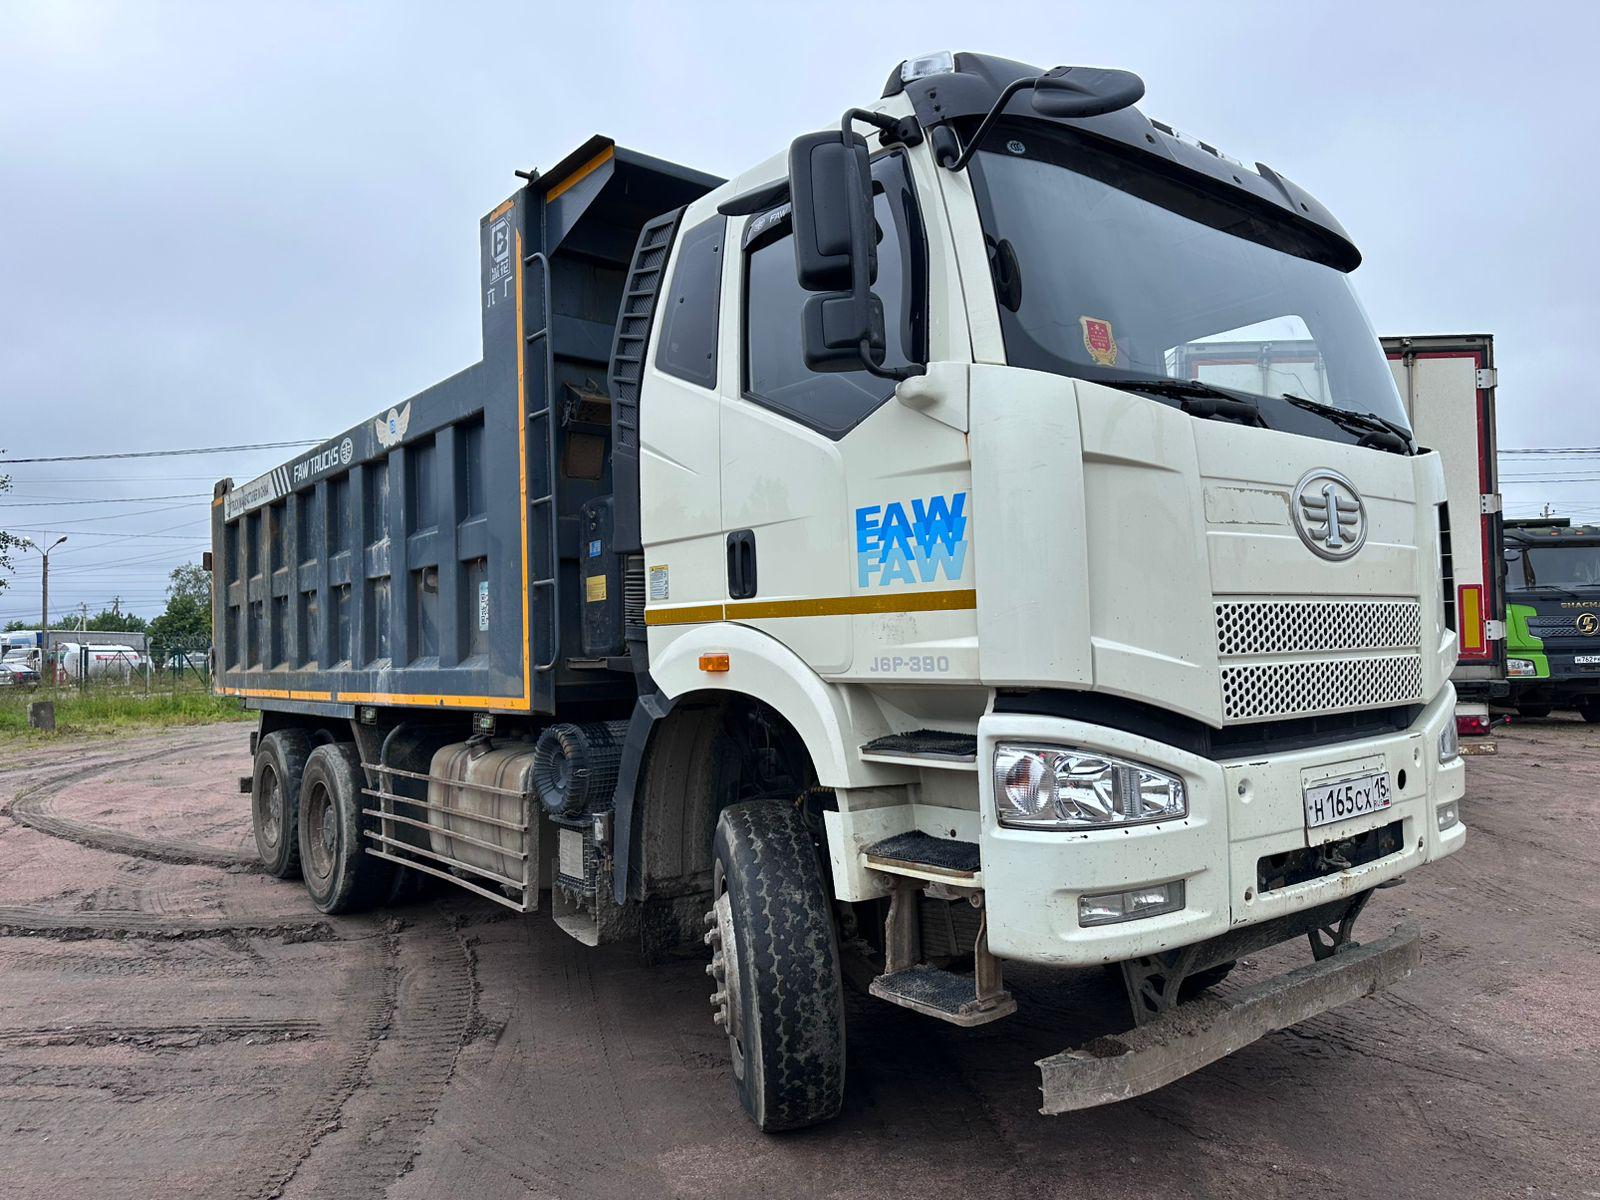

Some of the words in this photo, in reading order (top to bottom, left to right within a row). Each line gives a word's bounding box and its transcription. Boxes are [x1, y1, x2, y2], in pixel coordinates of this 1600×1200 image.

[769, 208, 788, 223] FAW
[293, 459, 309, 483] FAW
[310, 446, 339, 475] TRUCKS
[855, 492, 967, 541] FAW
[858, 540, 969, 588] FAW
[870, 655, 949, 673] J6P-390
[1374, 777, 1387, 798] 15
